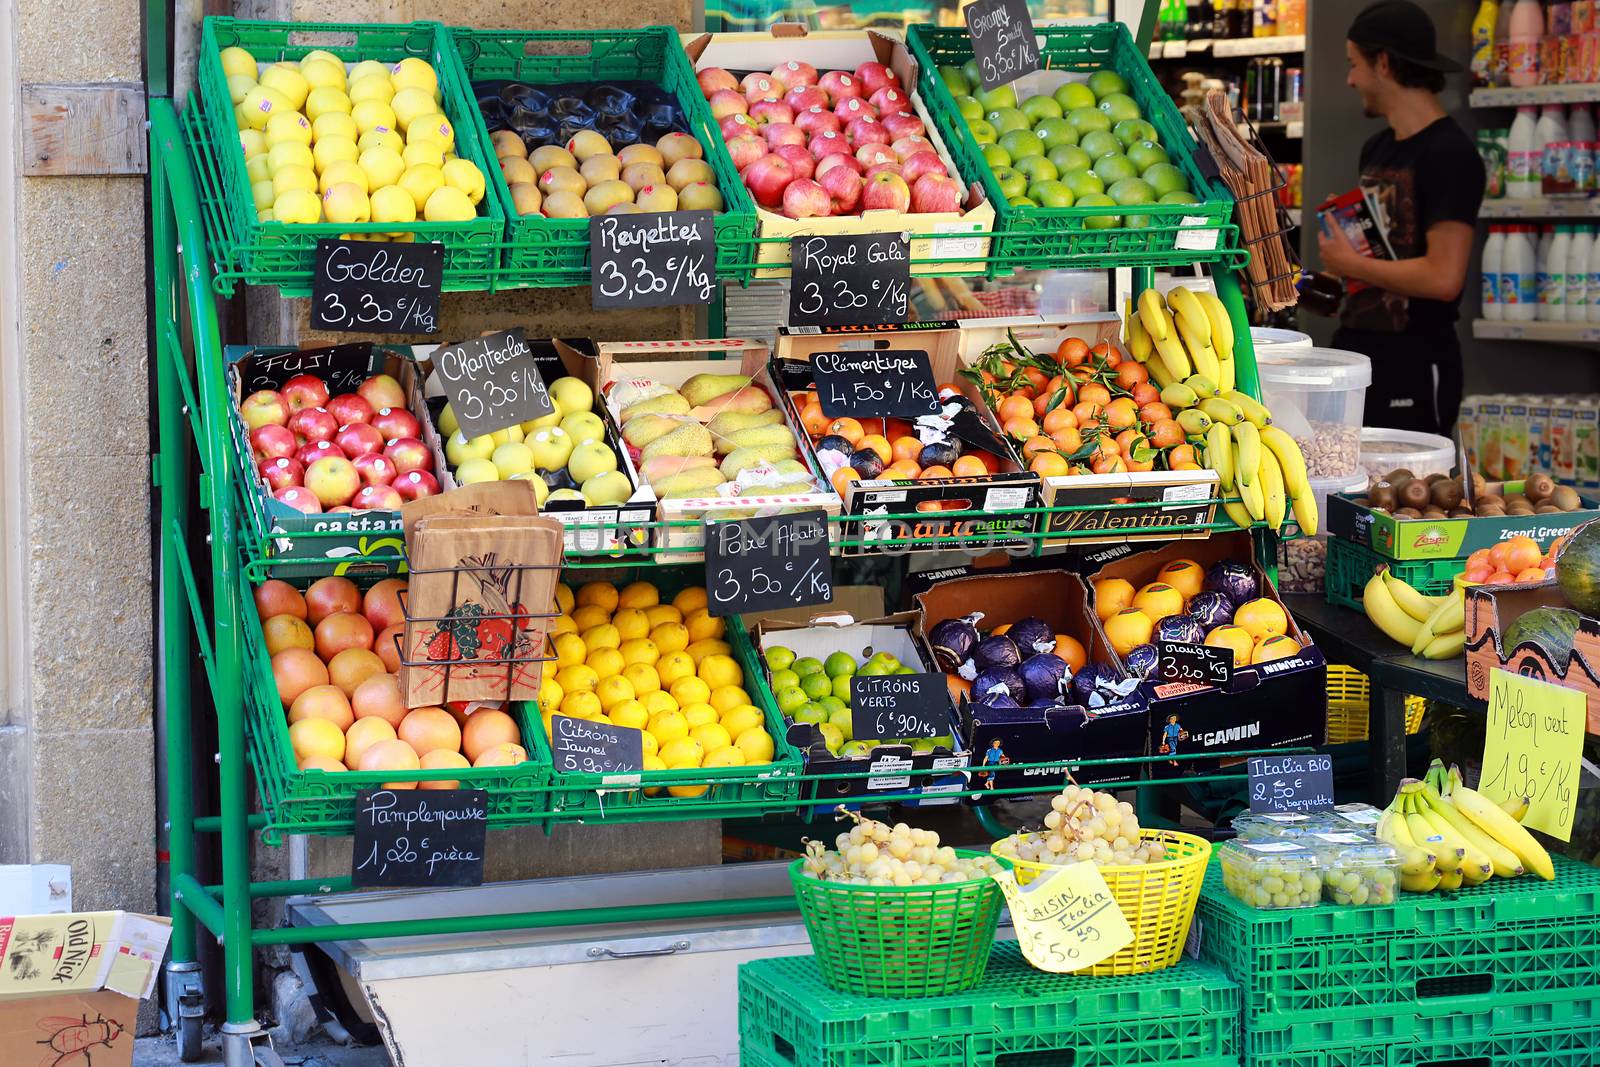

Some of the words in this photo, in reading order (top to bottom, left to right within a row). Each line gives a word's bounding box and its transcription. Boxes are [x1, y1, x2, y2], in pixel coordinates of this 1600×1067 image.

[601, 215, 701, 253] Reinettes
[326, 246, 431, 288] Golden
[805, 237, 856, 275] Royal
[867, 241, 906, 263] Gala
[902, 321, 941, 330] nature
[815, 352, 918, 375] Clémentines
[976, 518, 1027, 531] nature
[1053, 508, 1188, 531] Valentine
[1092, 545, 1132, 562] GAMIN
[927, 567, 967, 580] GAMIN
[1263, 658, 1305, 675] GAMIN
[860, 696, 896, 707] VERTS
[1494, 682, 1539, 747] Melon
[1544, 707, 1568, 735] vert
[1204, 721, 1261, 747] GAMIN
[1251, 757, 1306, 777] Italia
[363, 791, 487, 831] Pamplemousse
[1286, 794, 1334, 810] barquette
[426, 845, 481, 876] pièce
[1058, 892, 1108, 930] Italia
[67, 919, 89, 948] Old
[50, 949, 86, 984] Nick
